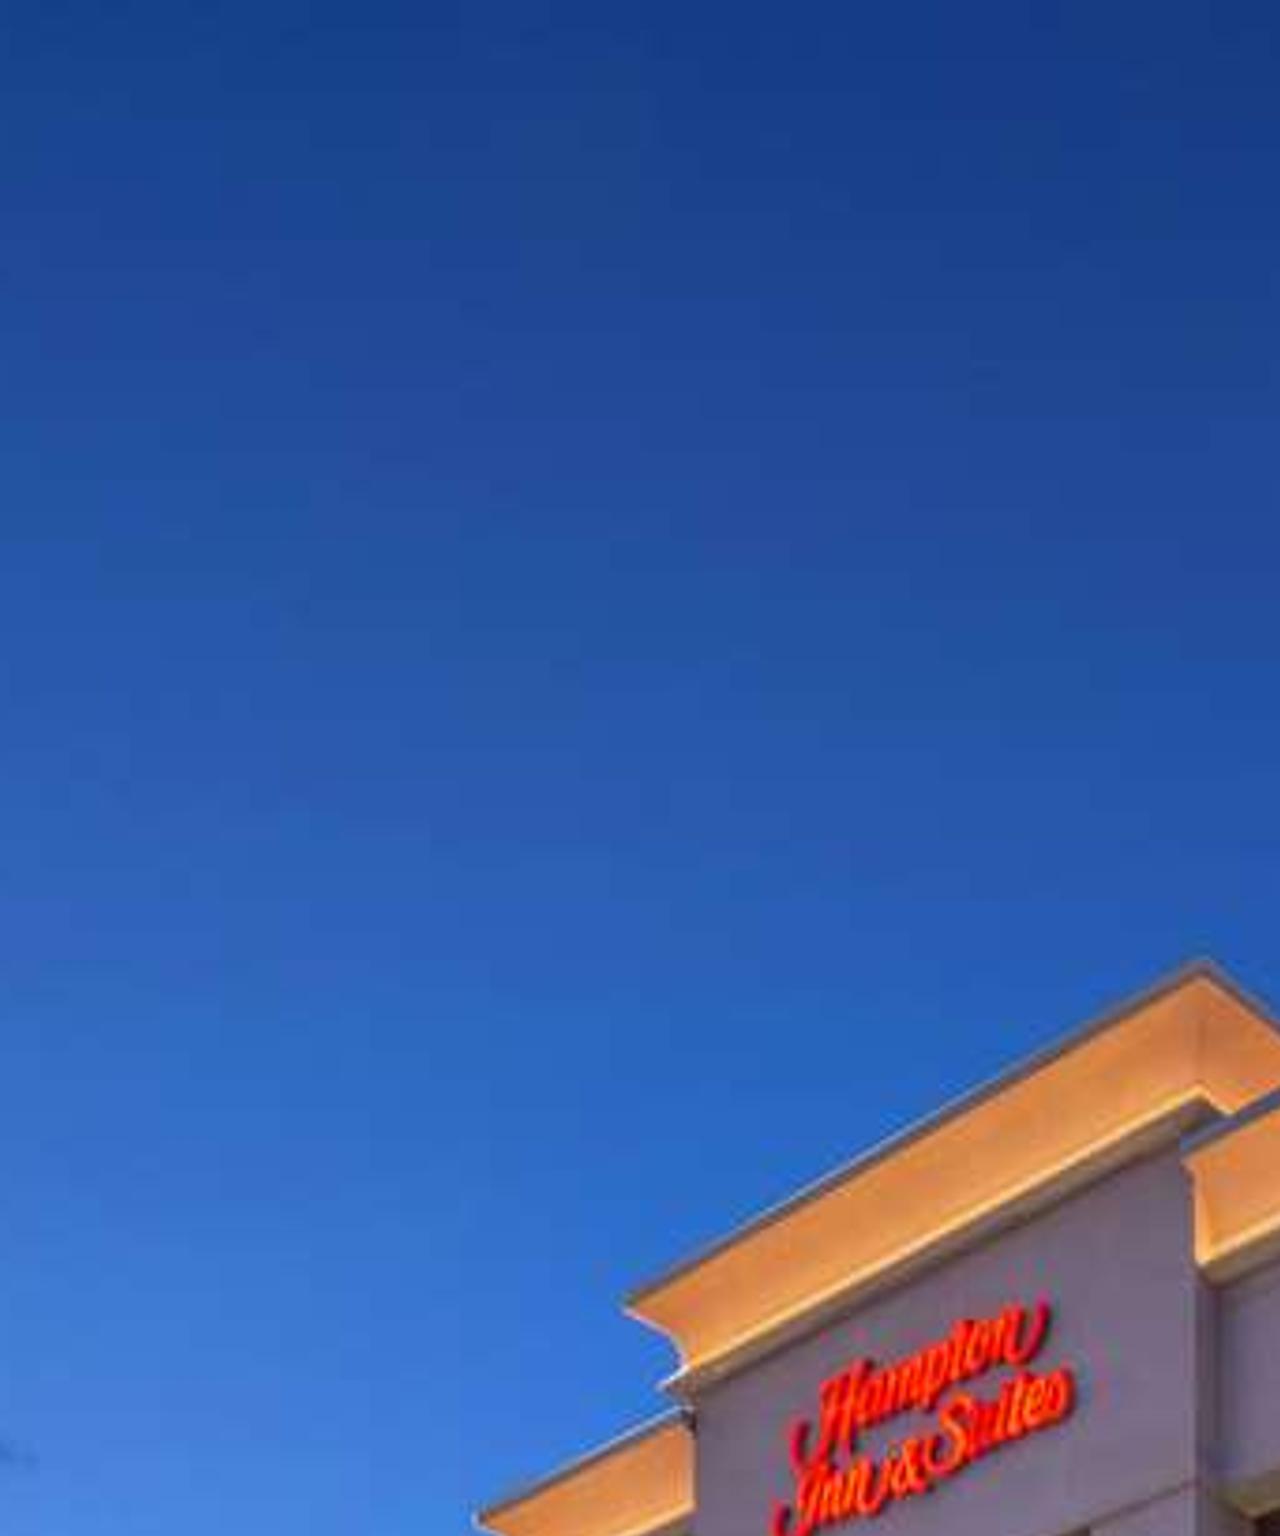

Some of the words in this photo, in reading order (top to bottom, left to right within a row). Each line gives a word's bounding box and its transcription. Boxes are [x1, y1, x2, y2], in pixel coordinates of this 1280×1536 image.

[790, 1301, 1051, 1472] Hampton
[885, 1437, 927, 1499] &
[923, 1367, 1075, 1476] Suites
